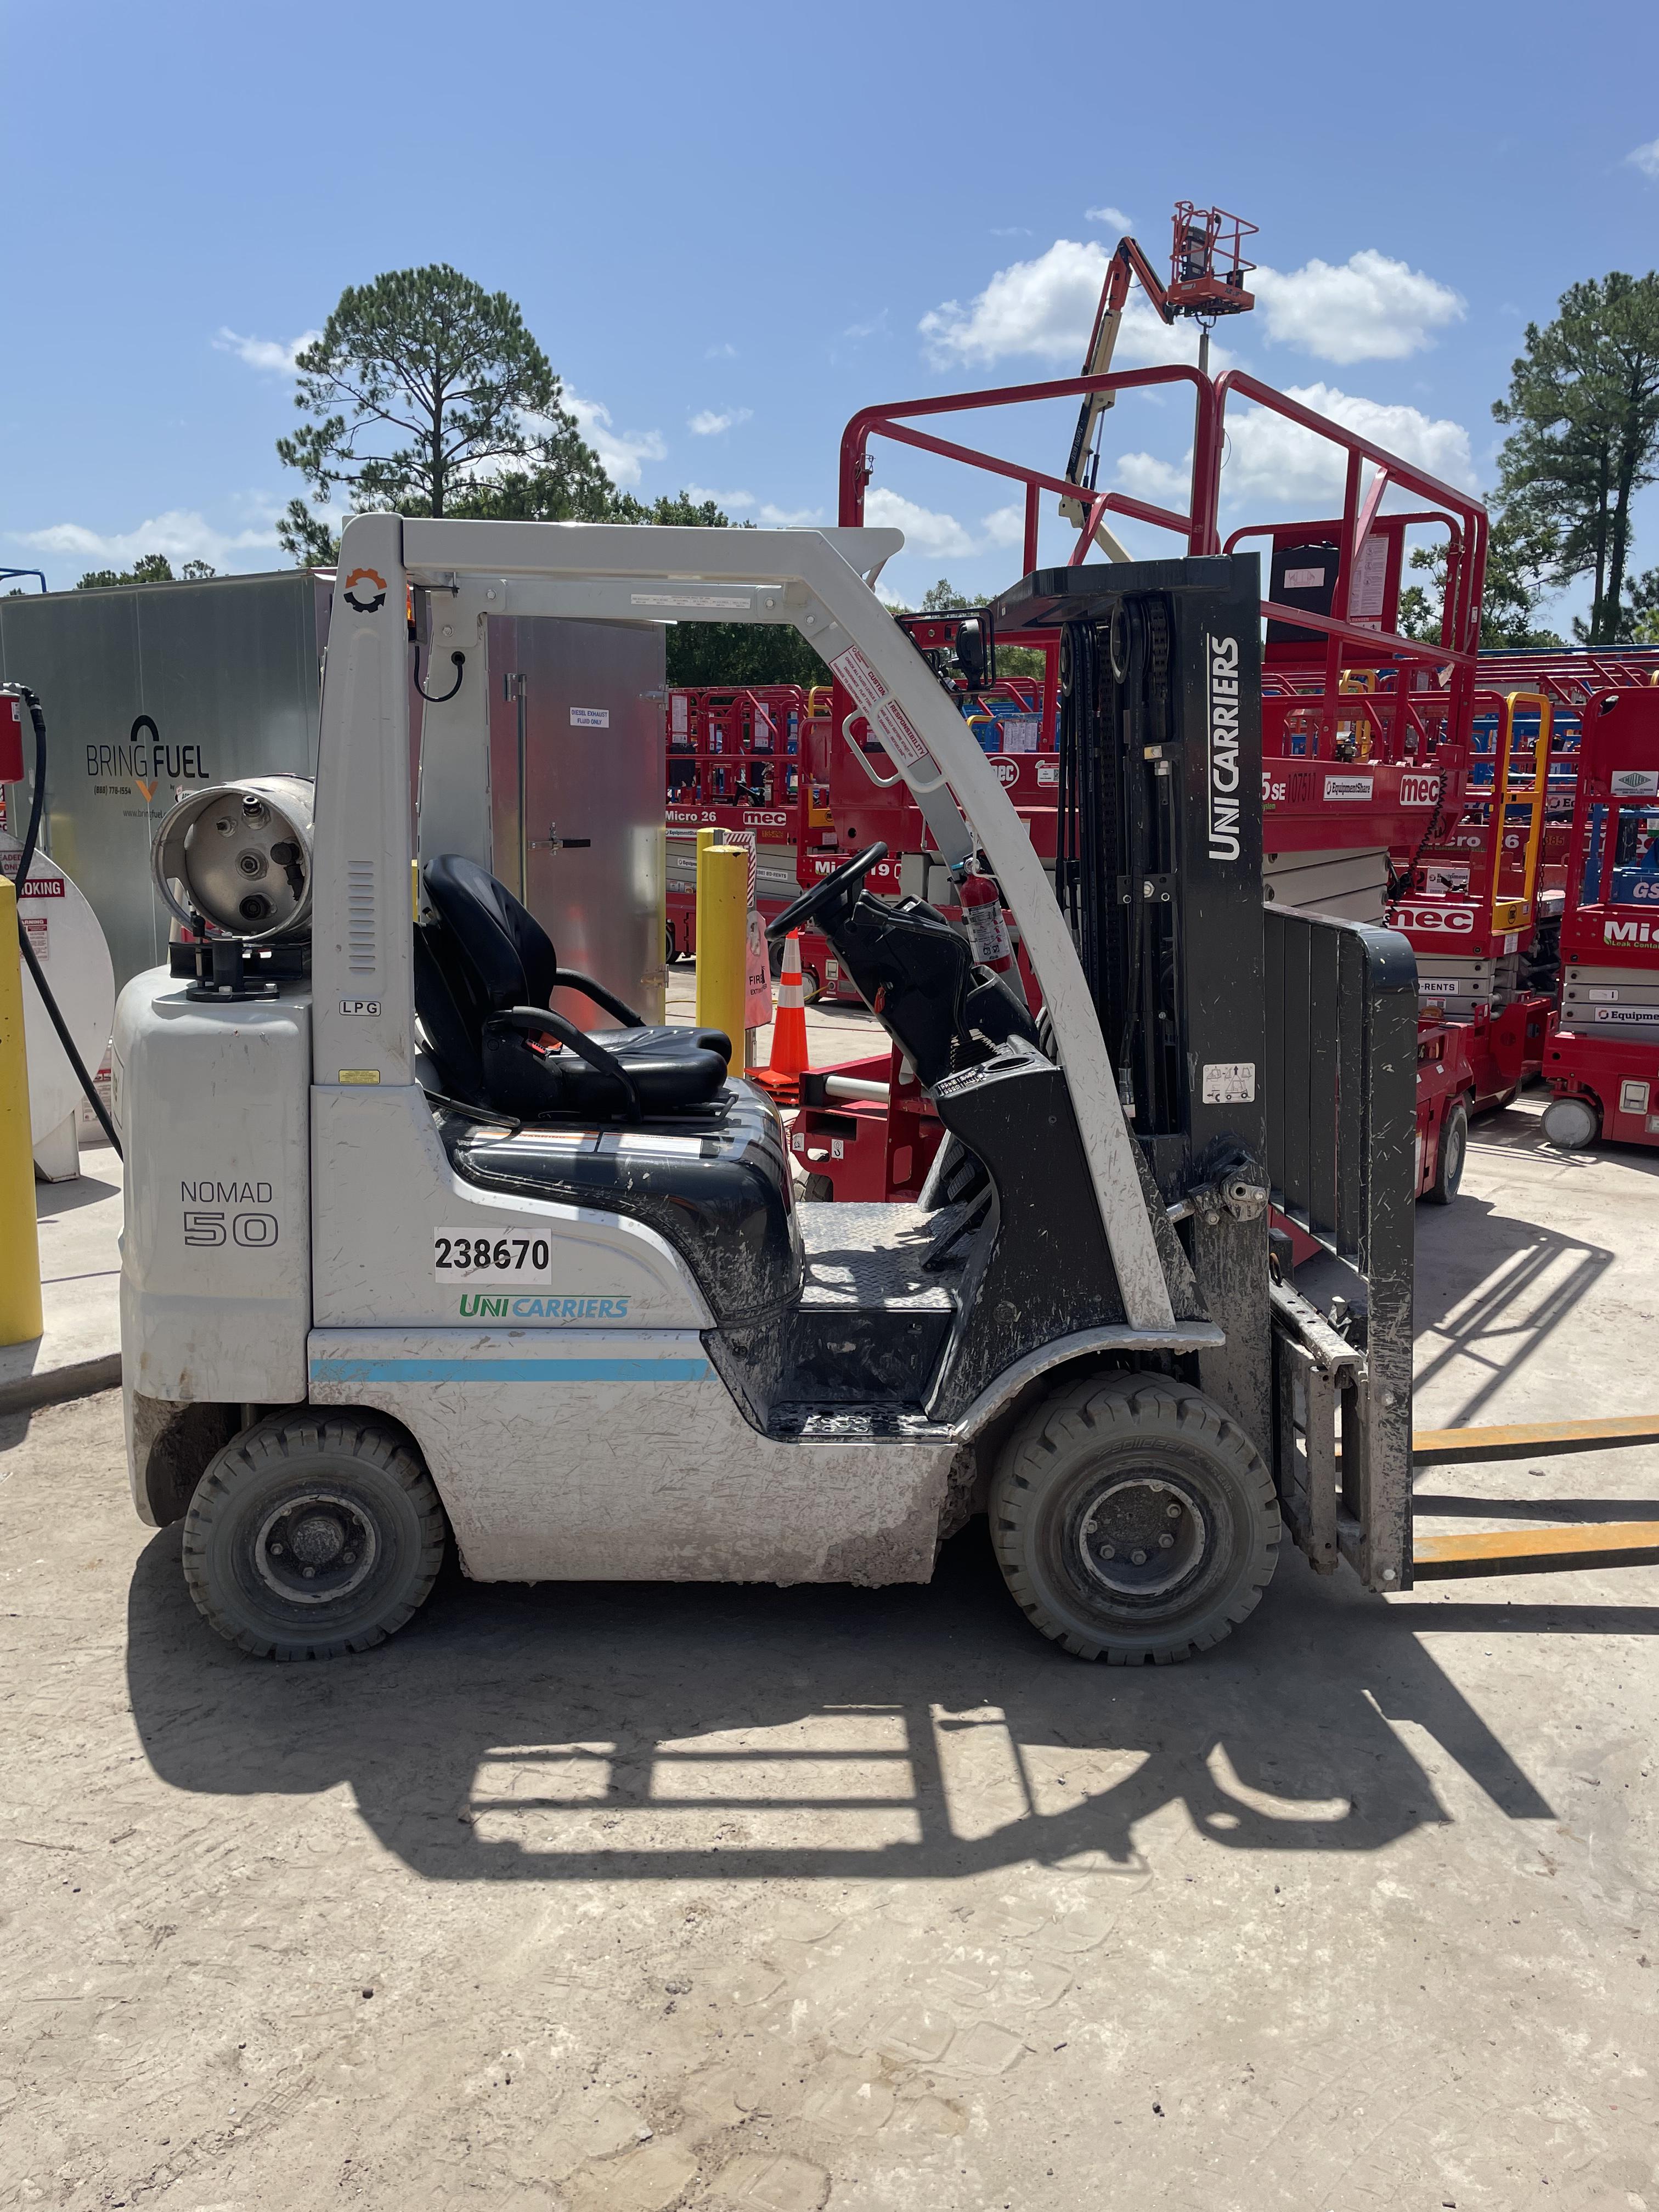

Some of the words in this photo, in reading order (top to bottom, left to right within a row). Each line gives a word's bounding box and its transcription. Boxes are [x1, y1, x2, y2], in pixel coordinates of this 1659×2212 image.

[889, 704, 926, 755] RESPONSIBILITY
[87, 745, 148, 777] BRING
[153, 745, 209, 778] FUEL
[94, 785, 108, 795] (888)
[109, 786, 131, 795] 778-1554
[1331, 782, 1370, 794] EquipmentShare
[1400, 776, 1439, 802] mec
[665, 810, 697, 821] Micro
[701, 811, 716, 822] 26
[744, 812, 786, 823] mec
[343, 1002, 377, 1014] LPG
[181, 1181, 272, 1203] NOMAD
[184, 1211, 278, 1248] 50
[435, 1238, 549, 1270] 238670
